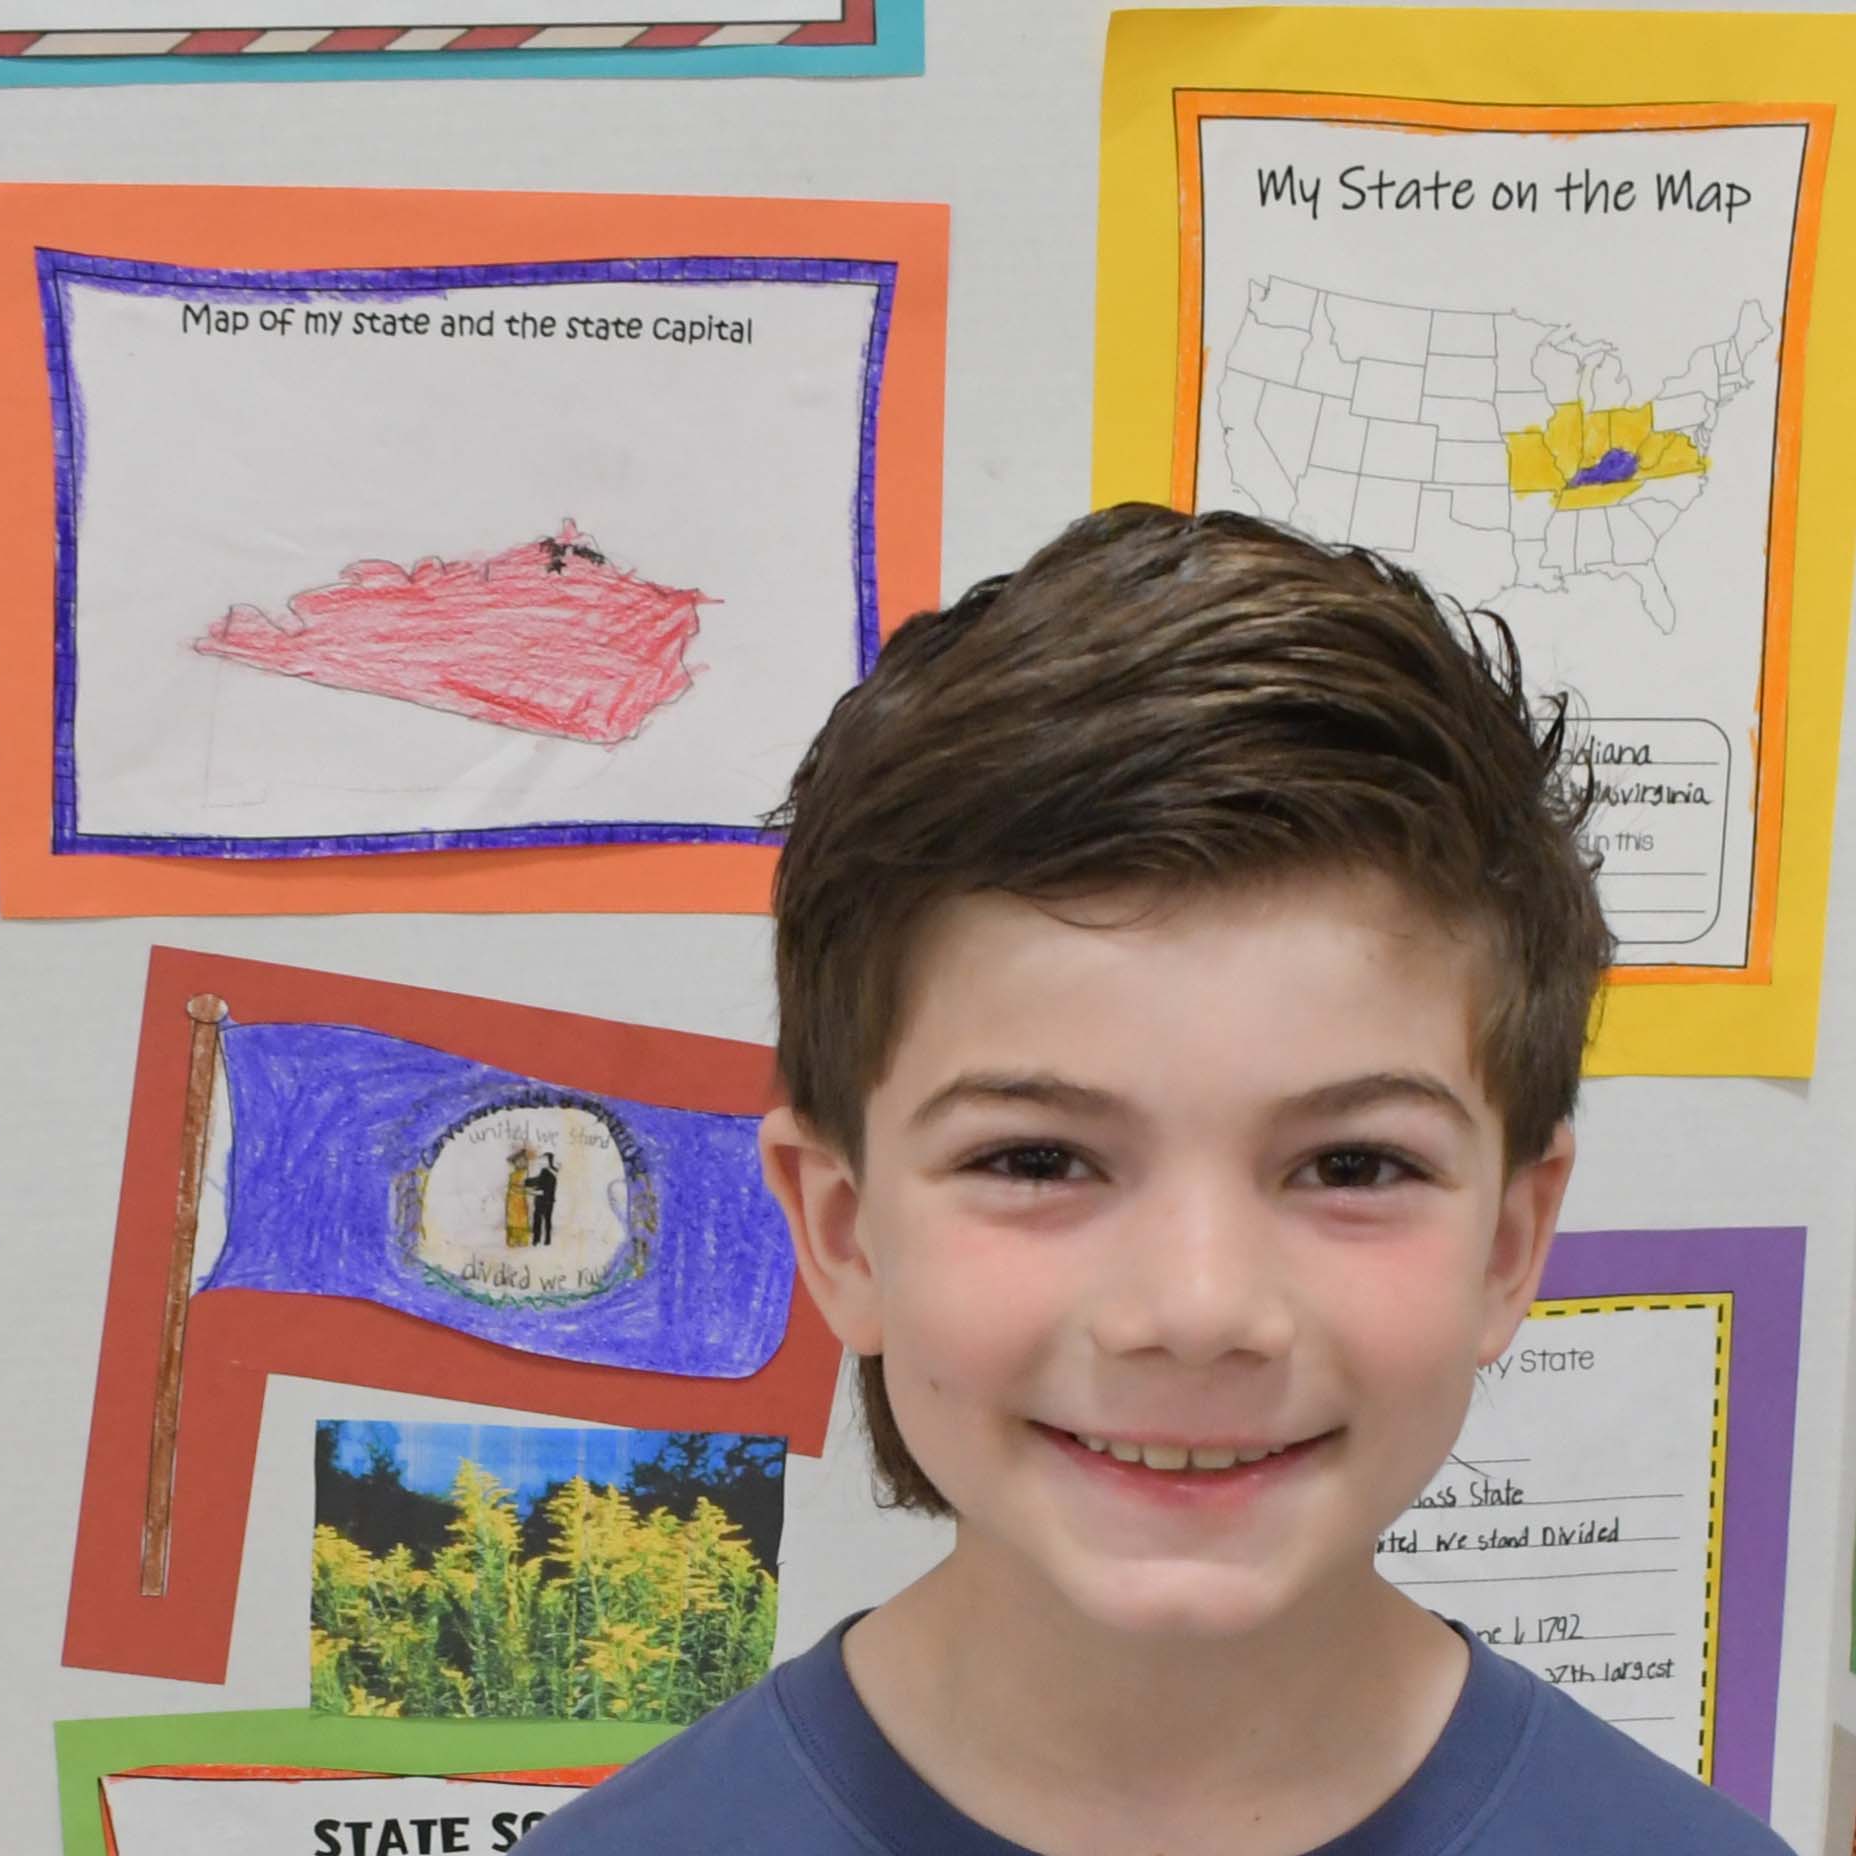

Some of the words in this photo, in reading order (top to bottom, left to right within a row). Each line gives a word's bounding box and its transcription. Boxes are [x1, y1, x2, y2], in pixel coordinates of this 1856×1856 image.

[1257, 164, 1321, 220] My
[1339, 165, 1475, 211] State
[1491, 180, 1537, 211] on
[1555, 168, 1637, 213] the
[1656, 169, 1752, 223] Map
[182, 303, 248, 338] Map
[259, 306, 296, 333] of
[304, 311, 343, 338] my
[352, 311, 430, 336] state
[441, 310, 494, 337] and
[505, 312, 556, 339] the
[566, 313, 643, 340] state
[653, 315, 753, 345] capital
[1615, 831, 1654, 852] this
[1520, 1347, 1594, 1373] State
[1469, 1478, 1525, 1506] State
[1478, 1526, 1530, 1550] stand
[1542, 1516, 1621, 1547] Divided
[1537, 1613, 1584, 1644] 1792
[1604, 1658, 1676, 1681] largest
